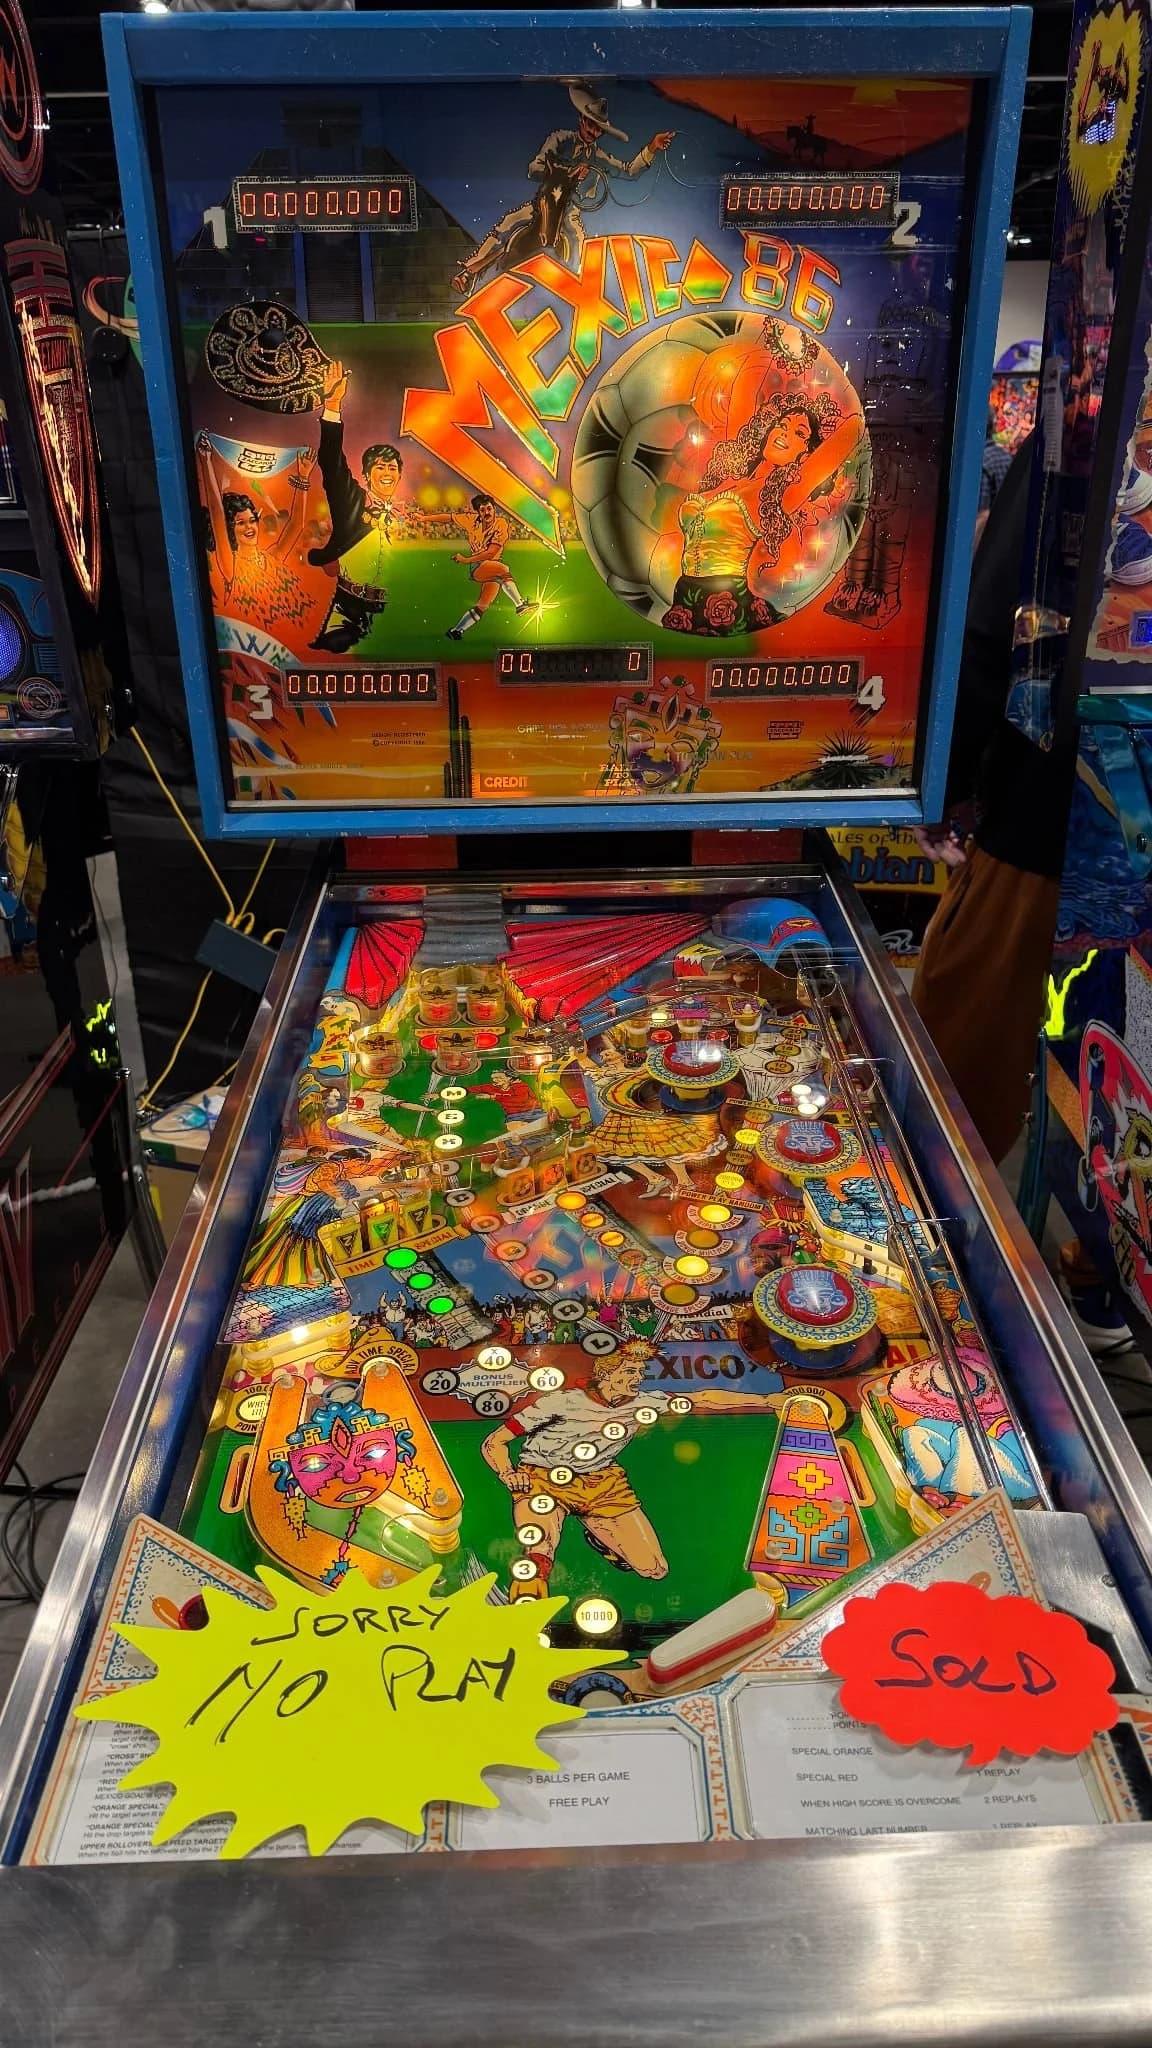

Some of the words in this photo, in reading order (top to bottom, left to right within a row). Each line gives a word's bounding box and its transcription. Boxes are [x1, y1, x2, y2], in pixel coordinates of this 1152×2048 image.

[204, 206, 228, 249] 1
[892, 202, 922, 245] 2
[399, 234, 733, 559] MEXICO
[740, 230, 841, 334] 86
[857, 676, 886, 710] 4
[245, 685, 274, 719] 3
[483, 776, 529, 788] CREDIT
[681, 1190, 706, 1200] POWER
[708, 1195, 726, 1204] PLAY
[358, 1345, 384, 1360] TIME
[388, 1345, 416, 1374] SPECIAL
[484, 1355, 505, 1367] 40
[430, 1379, 450, 1391] 20
[460, 1380, 527, 1388] MULTIPLIER
[536, 1376, 558, 1387] 60
[482, 1400, 504, 1412] 80
[670, 1400, 689, 1409] 10
[641, 1411, 651, 1420] 9
[609, 1426, 619, 1436] 8
[581, 1446, 590, 1456] 7
[556, 1470, 567, 1480] 6
[538, 1499, 548, 1509] 5
[524, 1530, 535, 1540] 4
[519, 1564, 530, 1575] 3
[251, 1604, 451, 1646] SORRY
[874, 1628, 1057, 1696] SOLD
[184, 1658, 329, 1745] NO
[381, 1644, 516, 1712] PLAY
[792, 1747, 831, 1756] SPECIAL
[833, 1747, 873, 1756] ORANGE
[526, 1776, 533, 1784] 3
[536, 1774, 570, 1784] BALLS
[573, 1773, 596, 1782] PER
[598, 1771, 631, 1781] GAME
[796, 1773, 835, 1782] SPECIAL
[838, 1773, 859, 1782] RED
[984, 1768, 1022, 1777] REPLAY
[549, 1797, 578, 1807] FREE
[581, 1796, 610, 1806] PLAY
[801, 1799, 830, 1807] WHEN
[832, 1799, 857, 1807] HIGH
[859, 1798, 893, 1807] SCORE
[895, 1798, 904, 1806] IS
[905, 1797, 962, 1806] OVERCOME
[984, 1796, 990, 1804] 2
[992, 1794, 1037, 1804] REPLAYS
[805, 1827, 857, 1836] MATCHING
[859, 1826, 885, 1835] LAST
